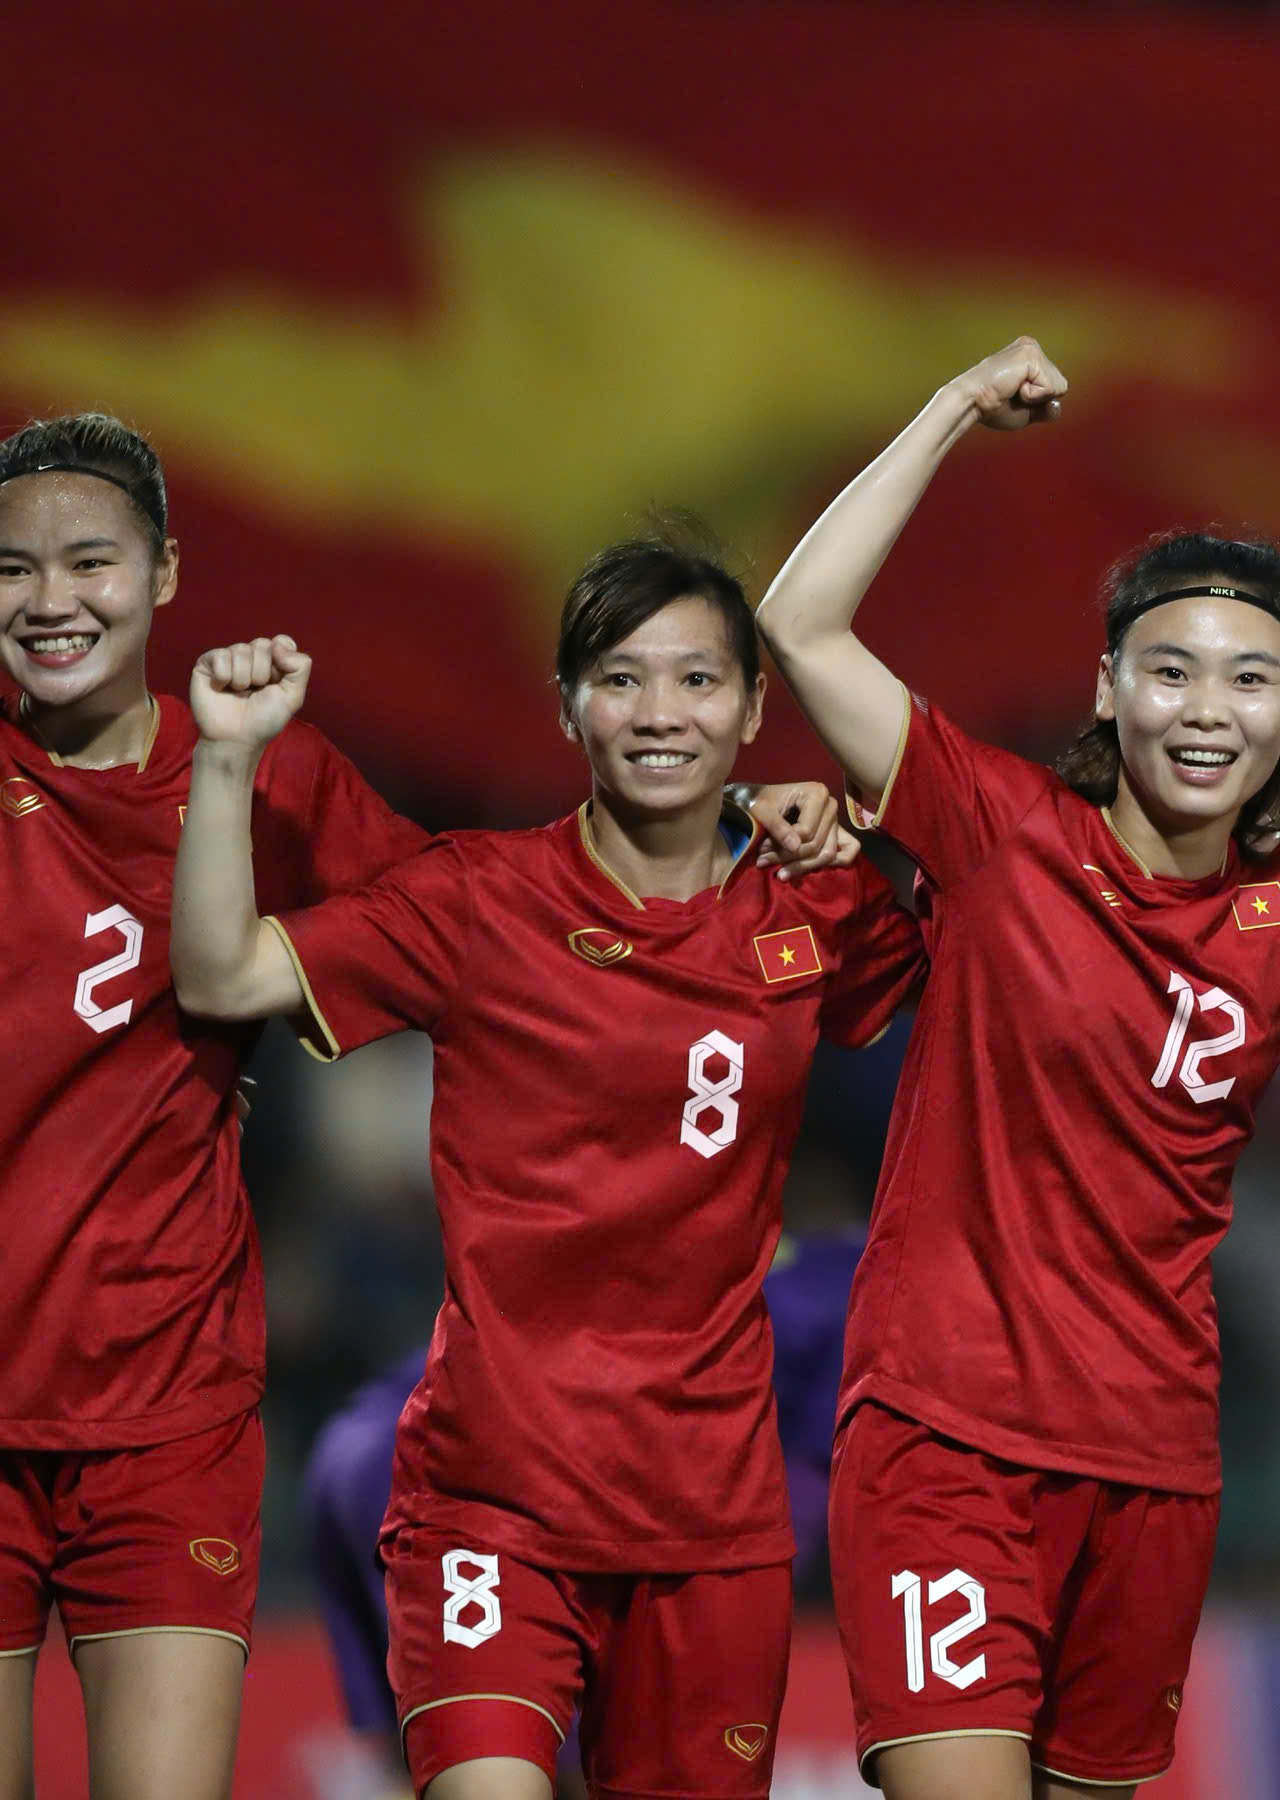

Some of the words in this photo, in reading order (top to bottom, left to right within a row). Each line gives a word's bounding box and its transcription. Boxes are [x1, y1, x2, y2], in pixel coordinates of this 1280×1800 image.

[1210, 587, 1236, 597] NIKE
[73, 903, 145, 1034] 2
[679, 1029, 745, 1159] 8
[1150, 970, 1246, 1105] 12
[441, 1548, 502, 1649] 8
[891, 1567, 987, 1694] 12
